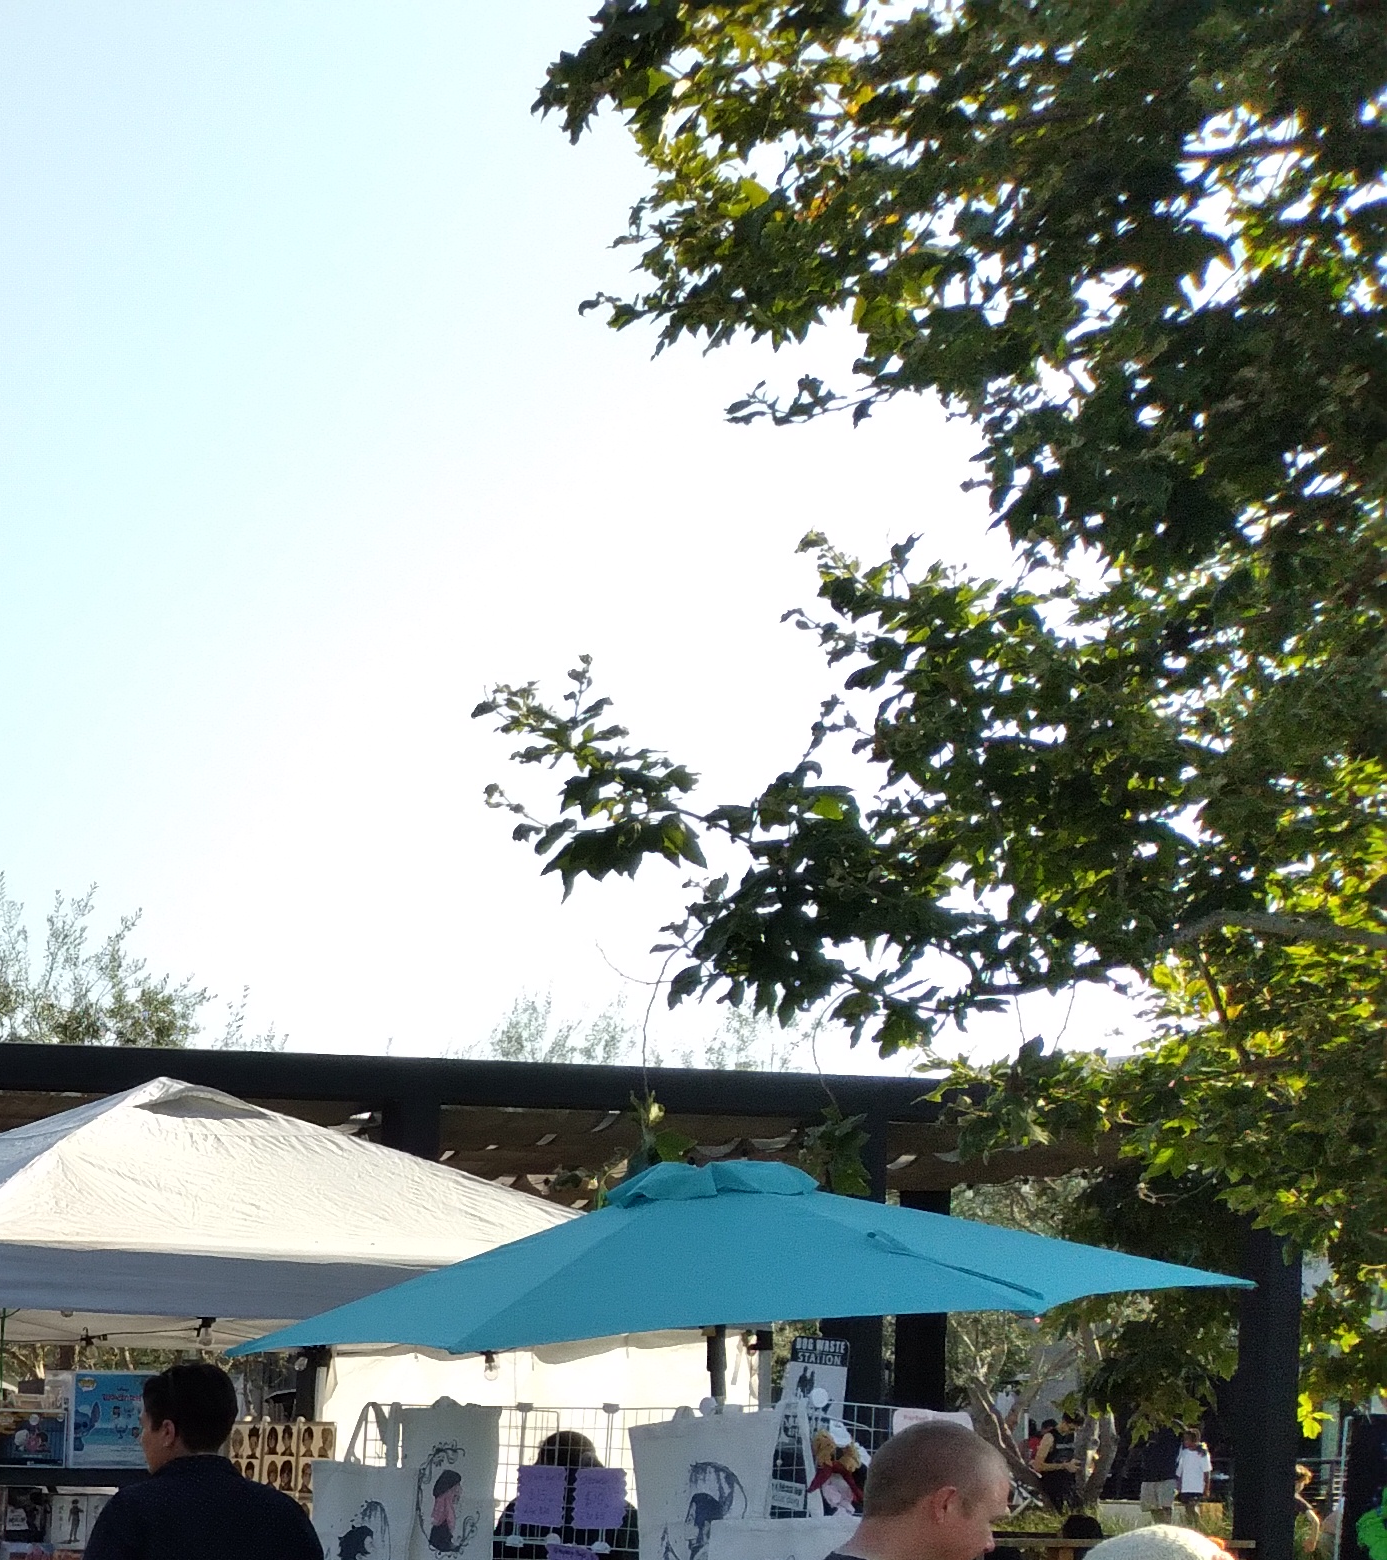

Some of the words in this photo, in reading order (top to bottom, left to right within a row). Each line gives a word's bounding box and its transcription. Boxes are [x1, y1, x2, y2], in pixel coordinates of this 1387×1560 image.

[796, 1337, 814, 1350] DOG
[816, 1339, 846, 1354] WASTE
[798, 1352, 842, 1365] STATION
